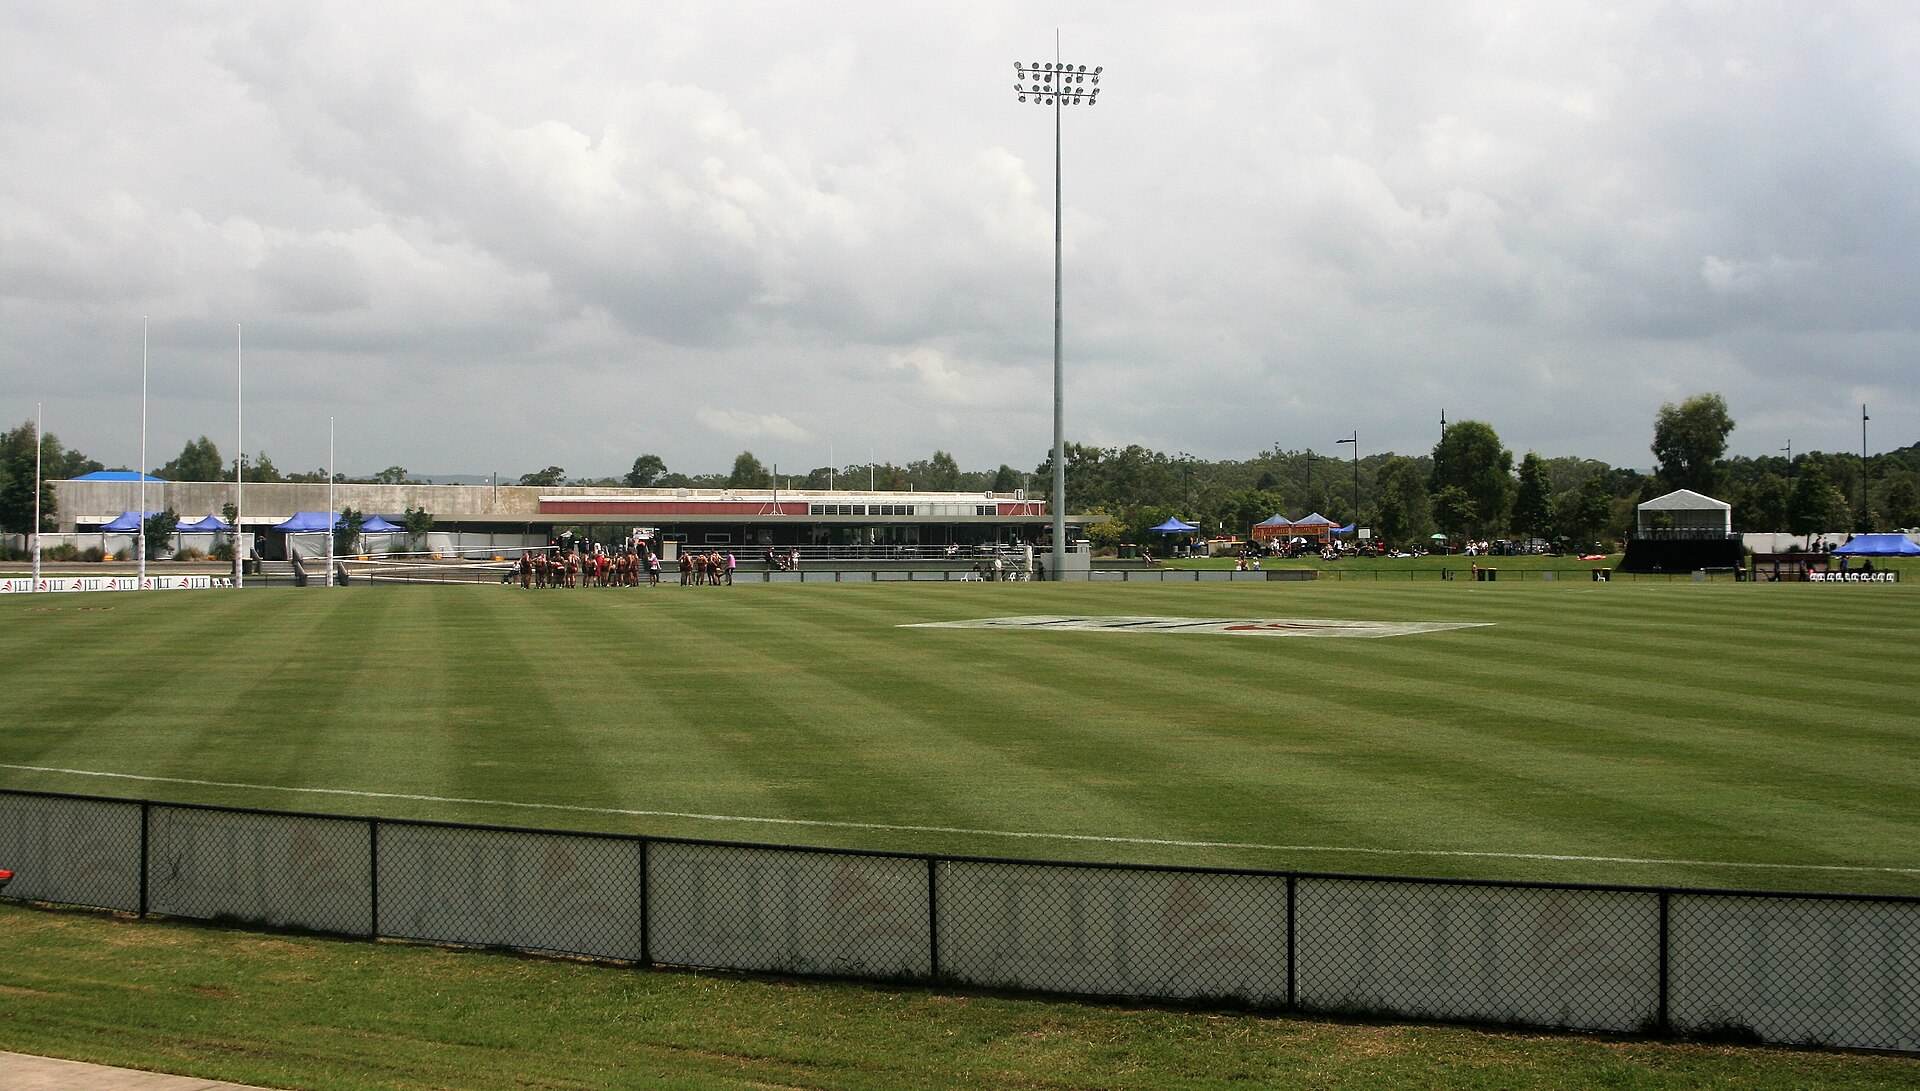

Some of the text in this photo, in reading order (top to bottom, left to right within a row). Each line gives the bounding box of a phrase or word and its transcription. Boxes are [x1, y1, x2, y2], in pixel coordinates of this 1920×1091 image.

[14, 580, 31, 593] JLT
[49, 579, 66, 592] JLT
[84, 579, 100, 592] JLT
[118, 578, 135, 592] JLT
[153, 578, 172, 590] JLT
[190, 577, 208, 590] JLT
